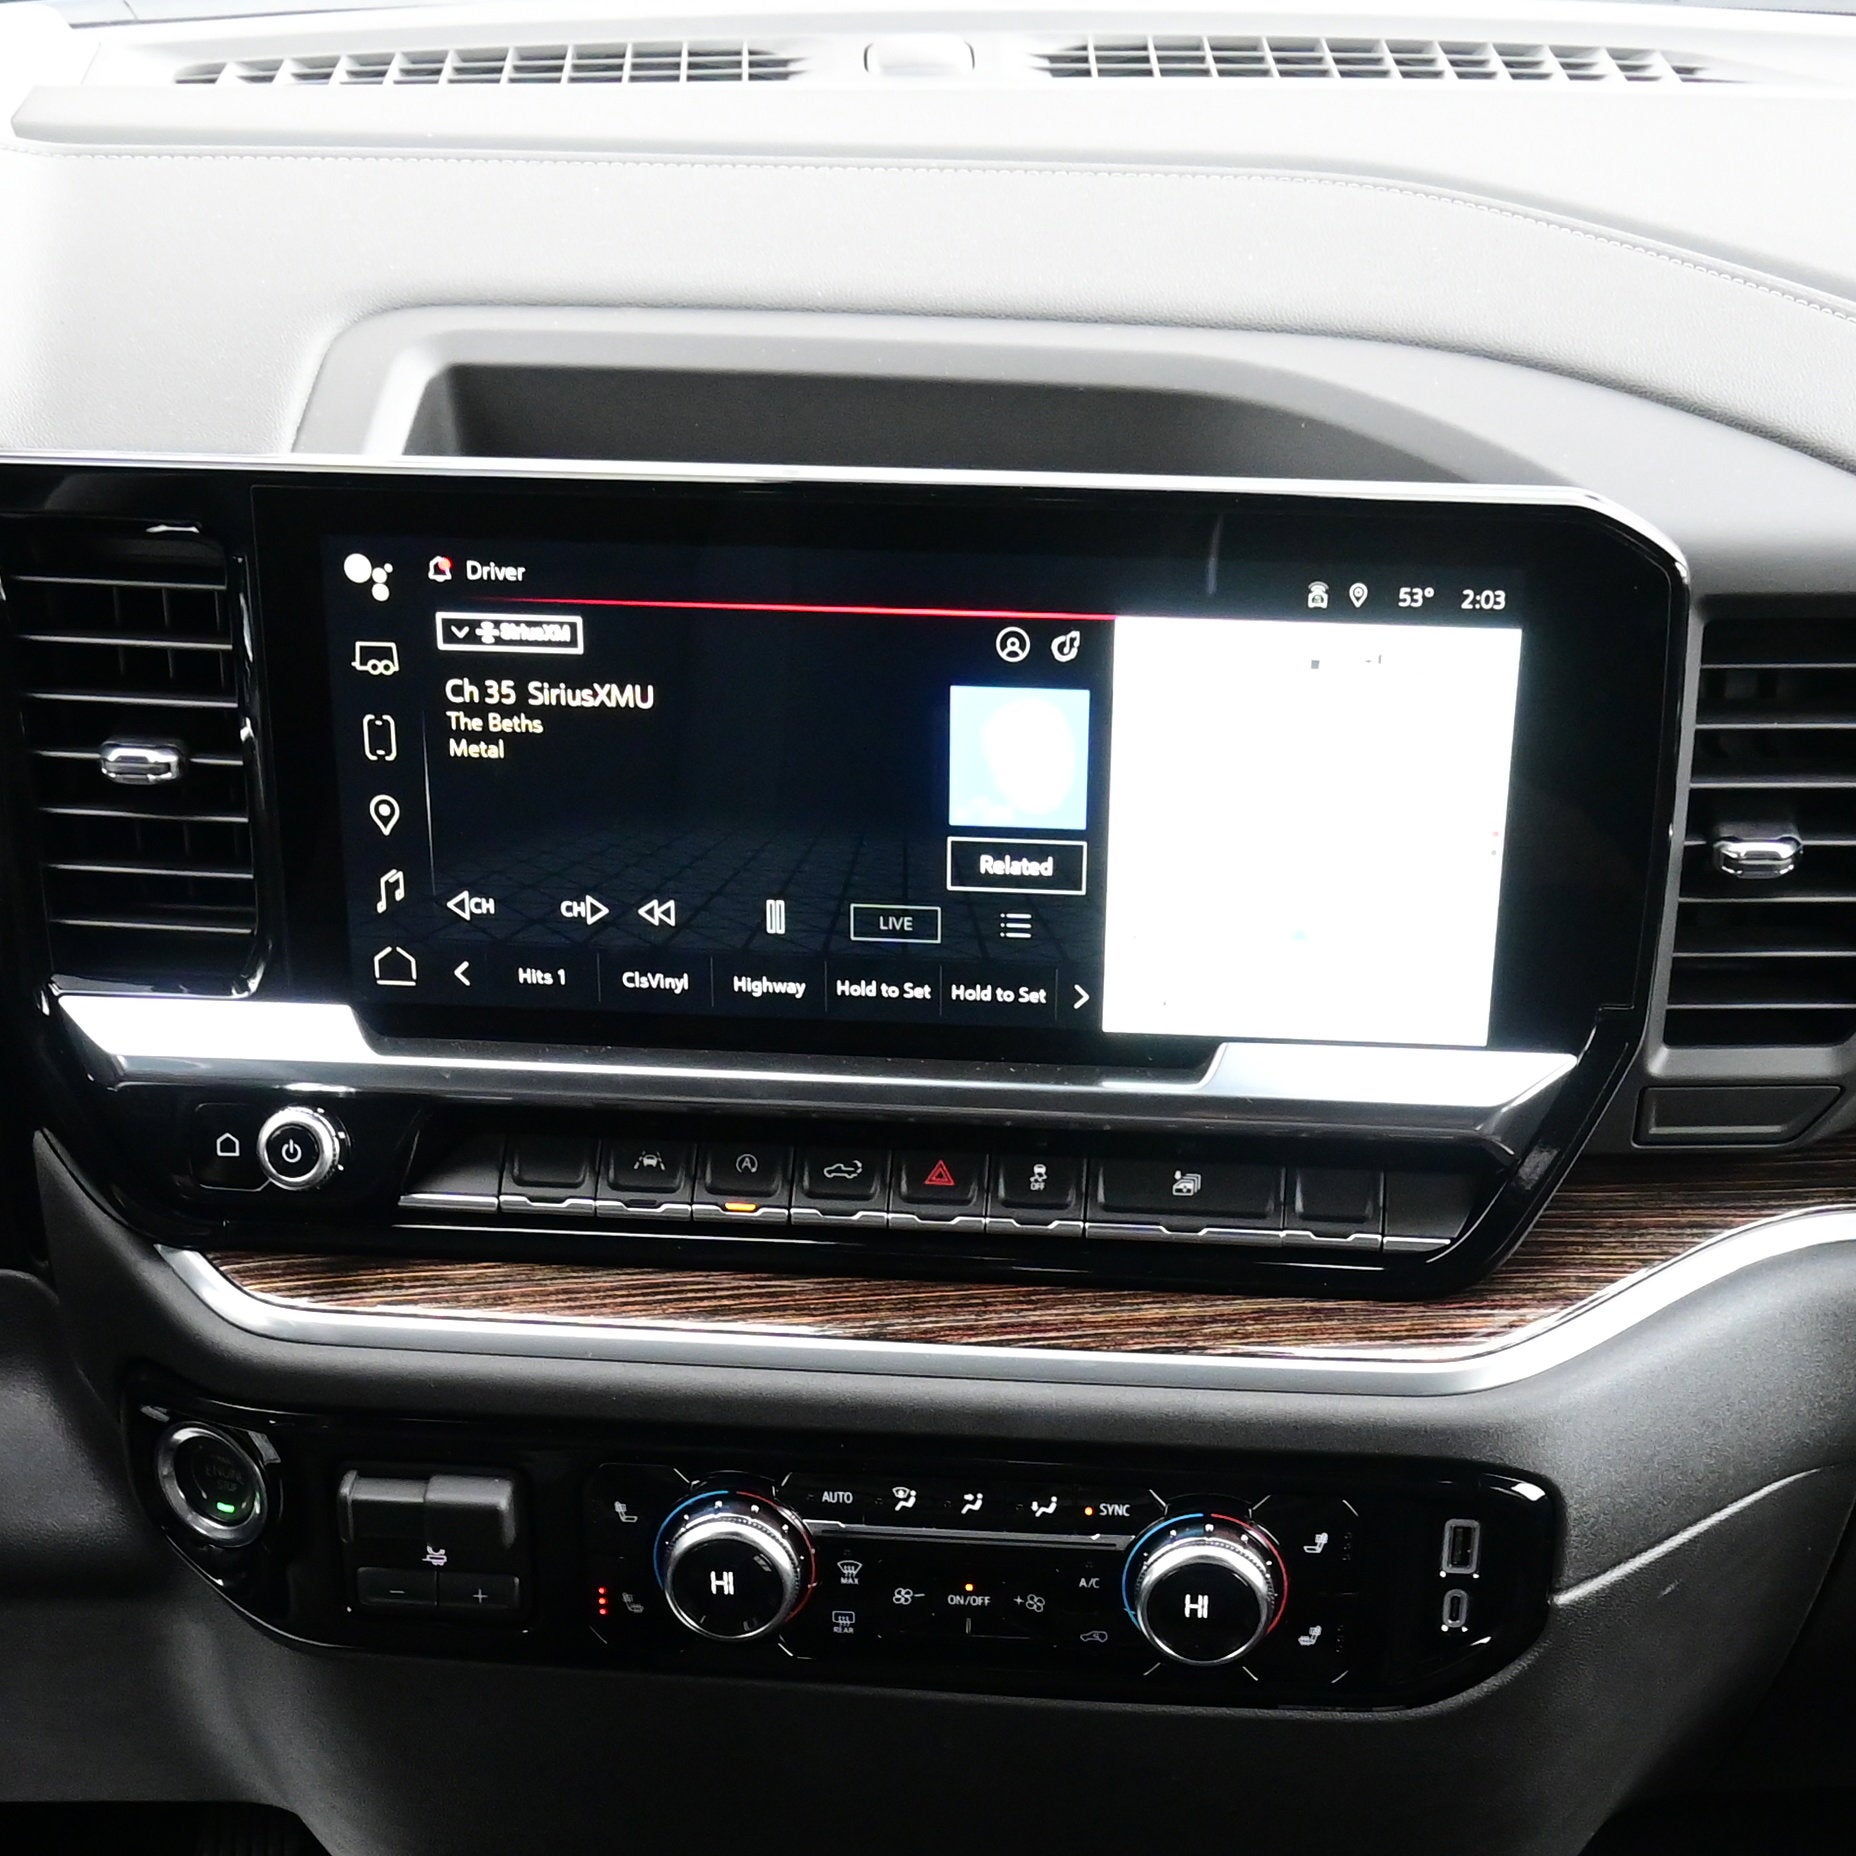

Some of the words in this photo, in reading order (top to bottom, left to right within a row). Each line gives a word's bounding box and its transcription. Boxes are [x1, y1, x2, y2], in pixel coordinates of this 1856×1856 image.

[466, 560, 526, 582] Driver
[1460, 588, 1506, 610] 2:03
[499, 622, 571, 642] SiriusXM
[445, 678, 479, 704] Ch
[484, 681, 516, 704] 35
[528, 681, 654, 709] SiriusXMU
[446, 711, 483, 732] The
[488, 713, 543, 734] Beths
[449, 739, 504, 759] Metal
[980, 854, 1053, 877] Related
[470, 897, 495, 915] CH
[560, 901, 586, 918] CH
[879, 916, 913, 932] LIVE
[518, 967, 554, 986] Hits
[558, 969, 566, 985] 1
[733, 975, 806, 999] Highway
[836, 980, 876, 998] Hold
[880, 983, 900, 999] to
[903, 982, 932, 1000] Set
[951, 984, 992, 1002] Hold
[995, 987, 1015, 1003] to
[1018, 986, 1047, 1004] Set
[822, 1491, 853, 1504] AUTO
[1099, 1503, 1131, 1518] SYNC
[710, 1571, 735, 1596] HI
[841, 1576, 859, 1585] MAX
[1079, 1577, 1100, 1590] A/C
[947, 1594, 991, 1607] ON/OFF
[1184, 1594, 1209, 1619] HI
